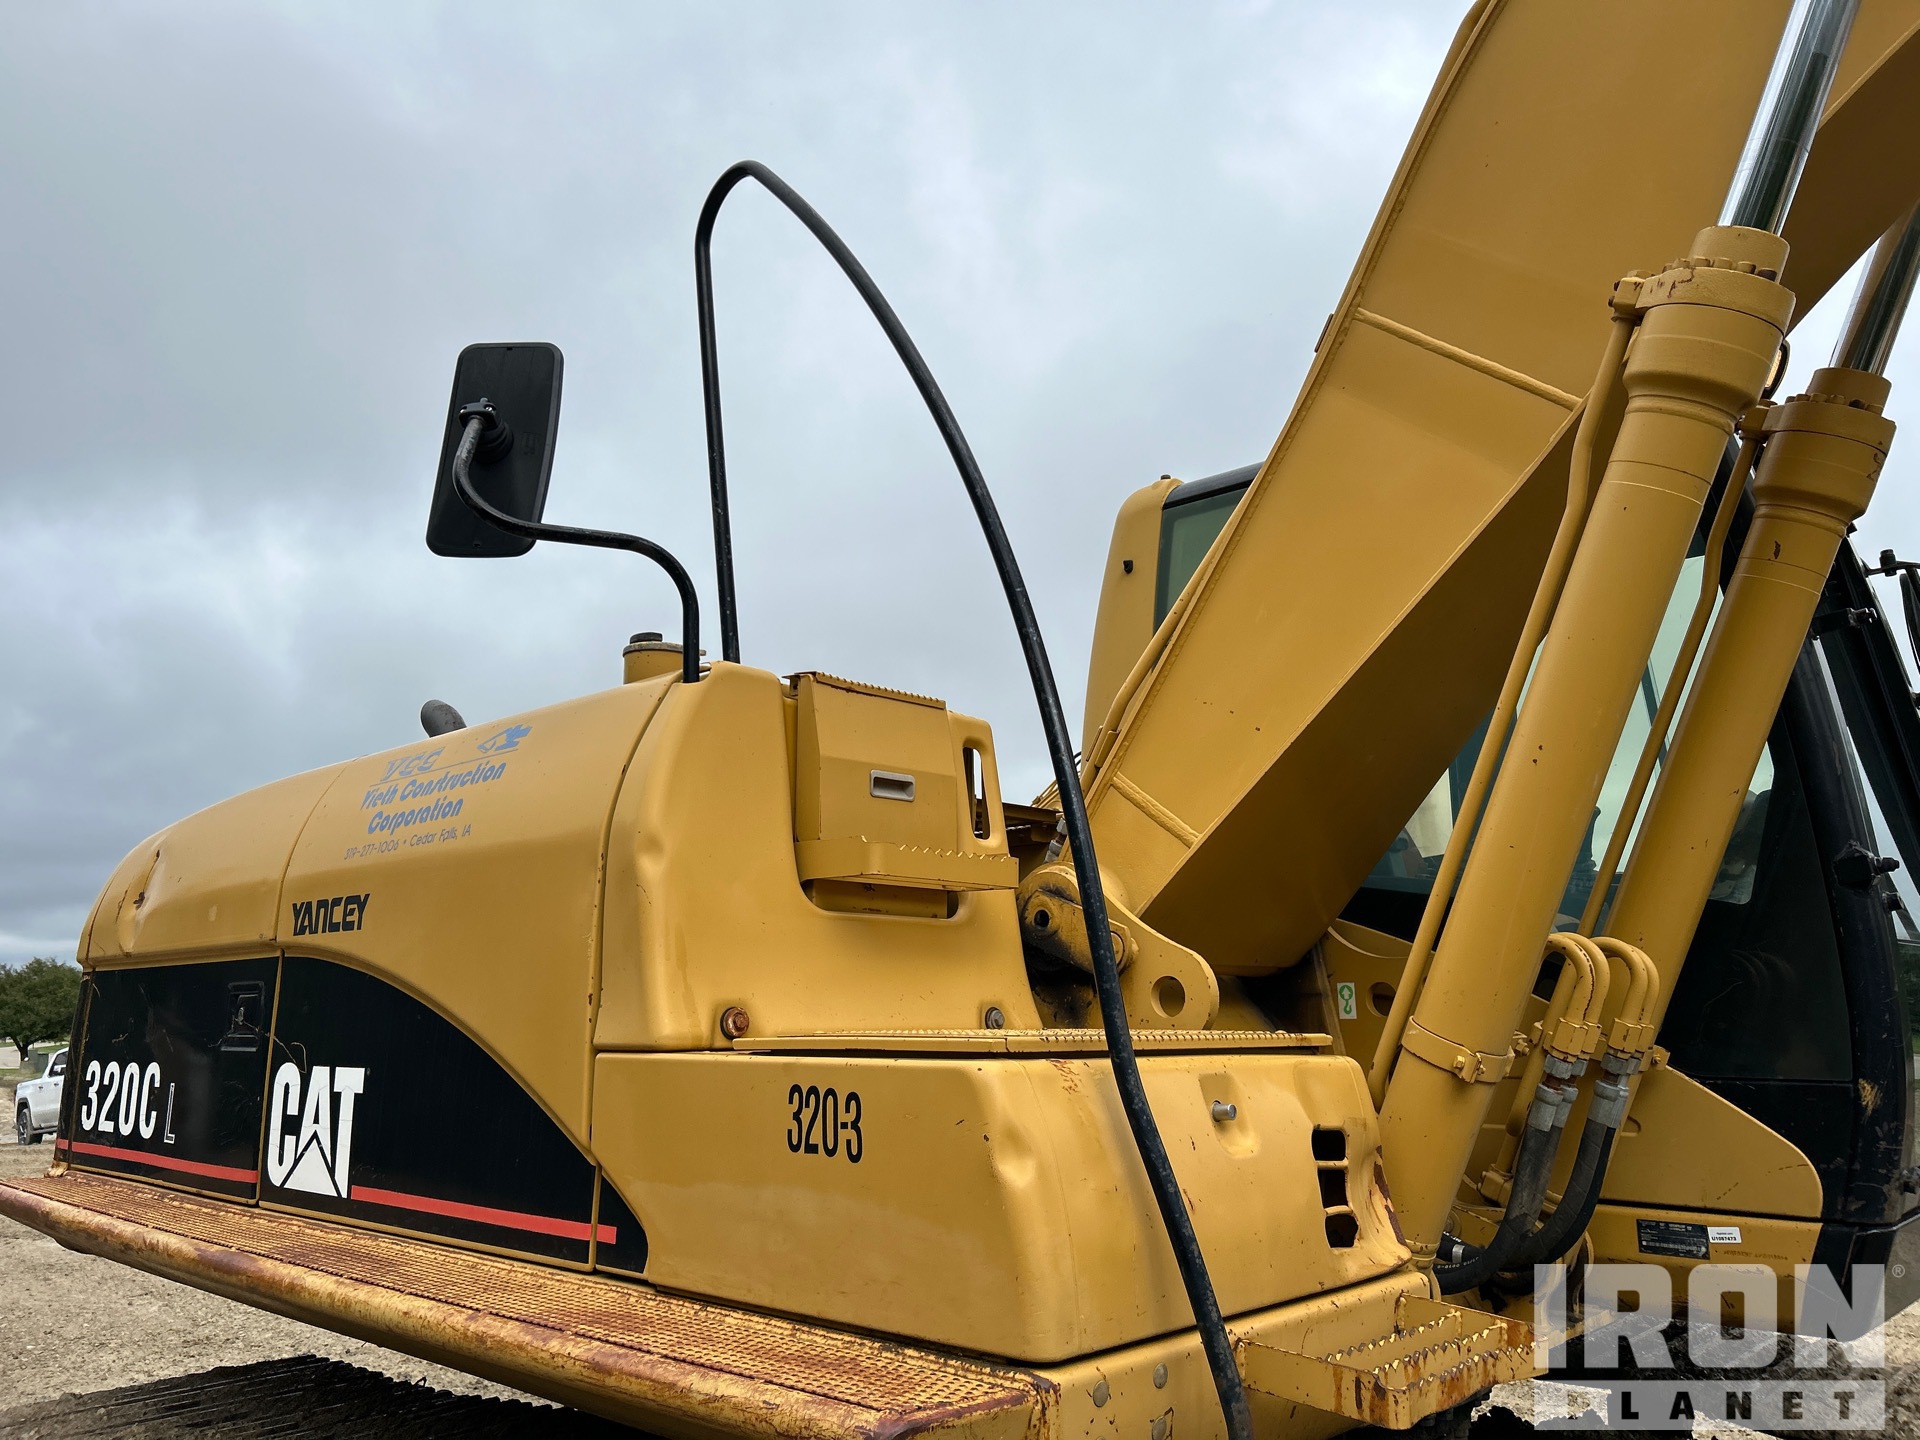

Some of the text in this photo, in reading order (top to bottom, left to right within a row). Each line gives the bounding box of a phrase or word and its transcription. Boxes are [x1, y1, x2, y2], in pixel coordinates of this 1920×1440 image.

[360, 760, 507, 811] Vieth Construction
[367, 795, 464, 835] Corporation
[410, 832, 437, 847] Cedar
[462, 824, 472, 837] IA
[292, 893, 371, 936] YANCEY
[81, 1060, 161, 1139] 320C
[787, 1083, 863, 1164] 320-3
[267, 1062, 366, 1199] CAT
